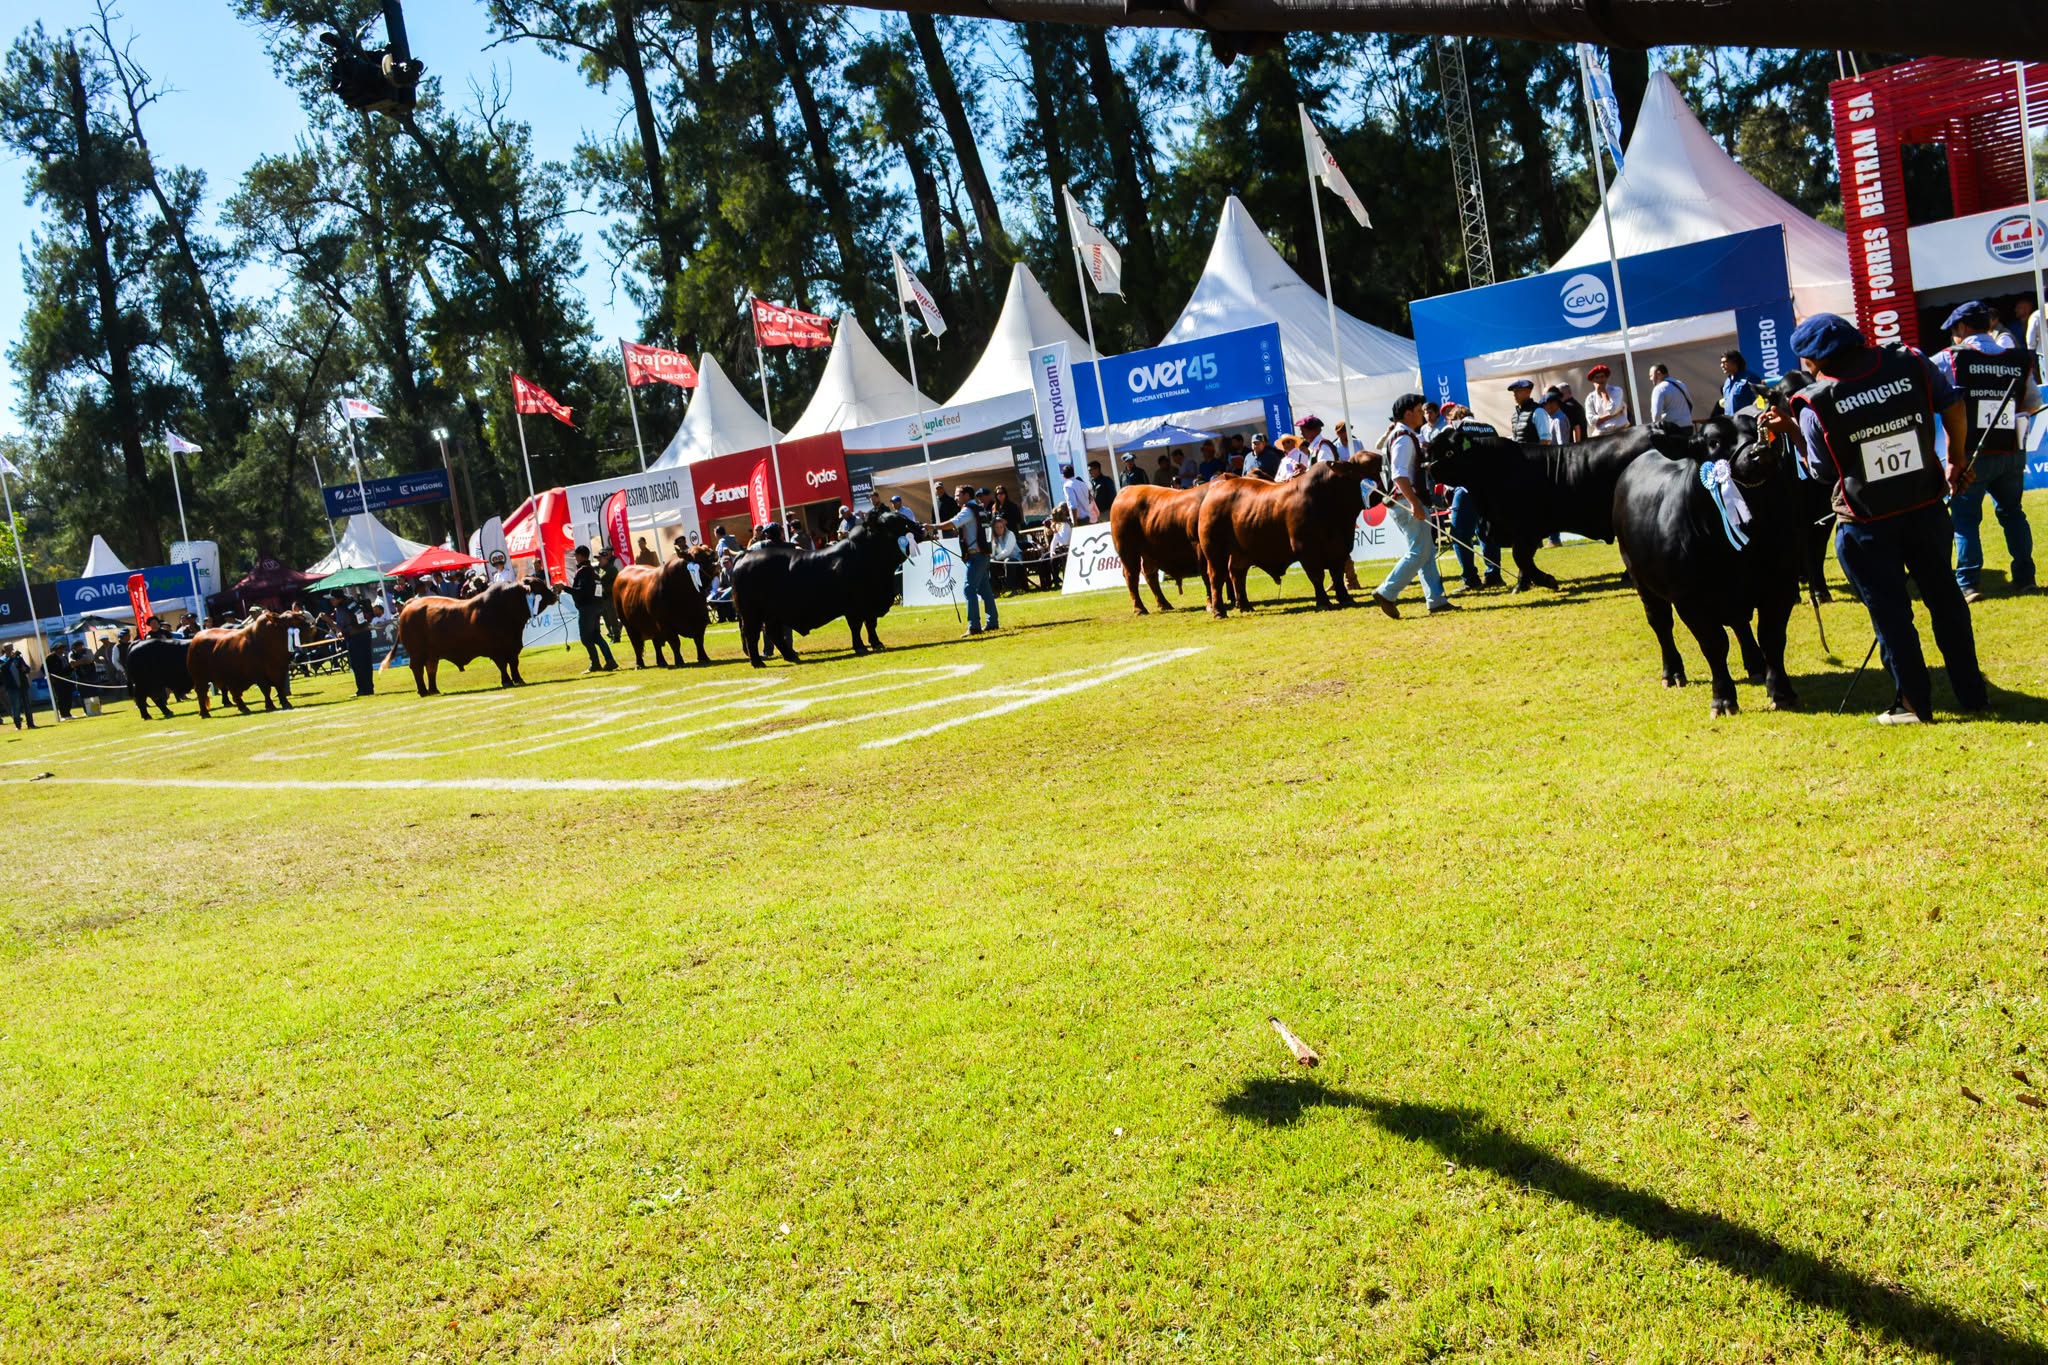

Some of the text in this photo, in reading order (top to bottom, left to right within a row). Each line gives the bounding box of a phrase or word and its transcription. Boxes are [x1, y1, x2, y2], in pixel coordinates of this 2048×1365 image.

[1847, 91, 1875, 122] SA
[1851, 127, 1885, 219] BELTRAN
[1863, 226, 1896, 301] FORRES
[1566, 292, 1606, 308] ceva
[1758, 319, 1781, 381] AQUERO
[1128, 353, 1218, 393] over 45
[1969, 364, 2022, 377] BRANGUS
[1049, 365, 1067, 435] Florxicam
[1132, 388, 1190, 403] MEDICINA VETERINARIA
[1438, 375, 1451, 405] REC
[1835, 377, 1913, 415] BRANGUS
[1970, 389, 2007, 397] BIOPOLIG
[924, 411, 961, 431] uplefeed
[1915, 412, 1923, 424] Q
[1984, 412, 2009, 426] 18
[1874, 449, 1912, 475] 107
[649, 475, 680, 503] DESAFÍO
[805, 469, 838, 489] Cyclos
[715, 485, 748, 503] HON
[614, 502, 629, 553] HONDA
[1354, 527, 1385, 546] RNE
